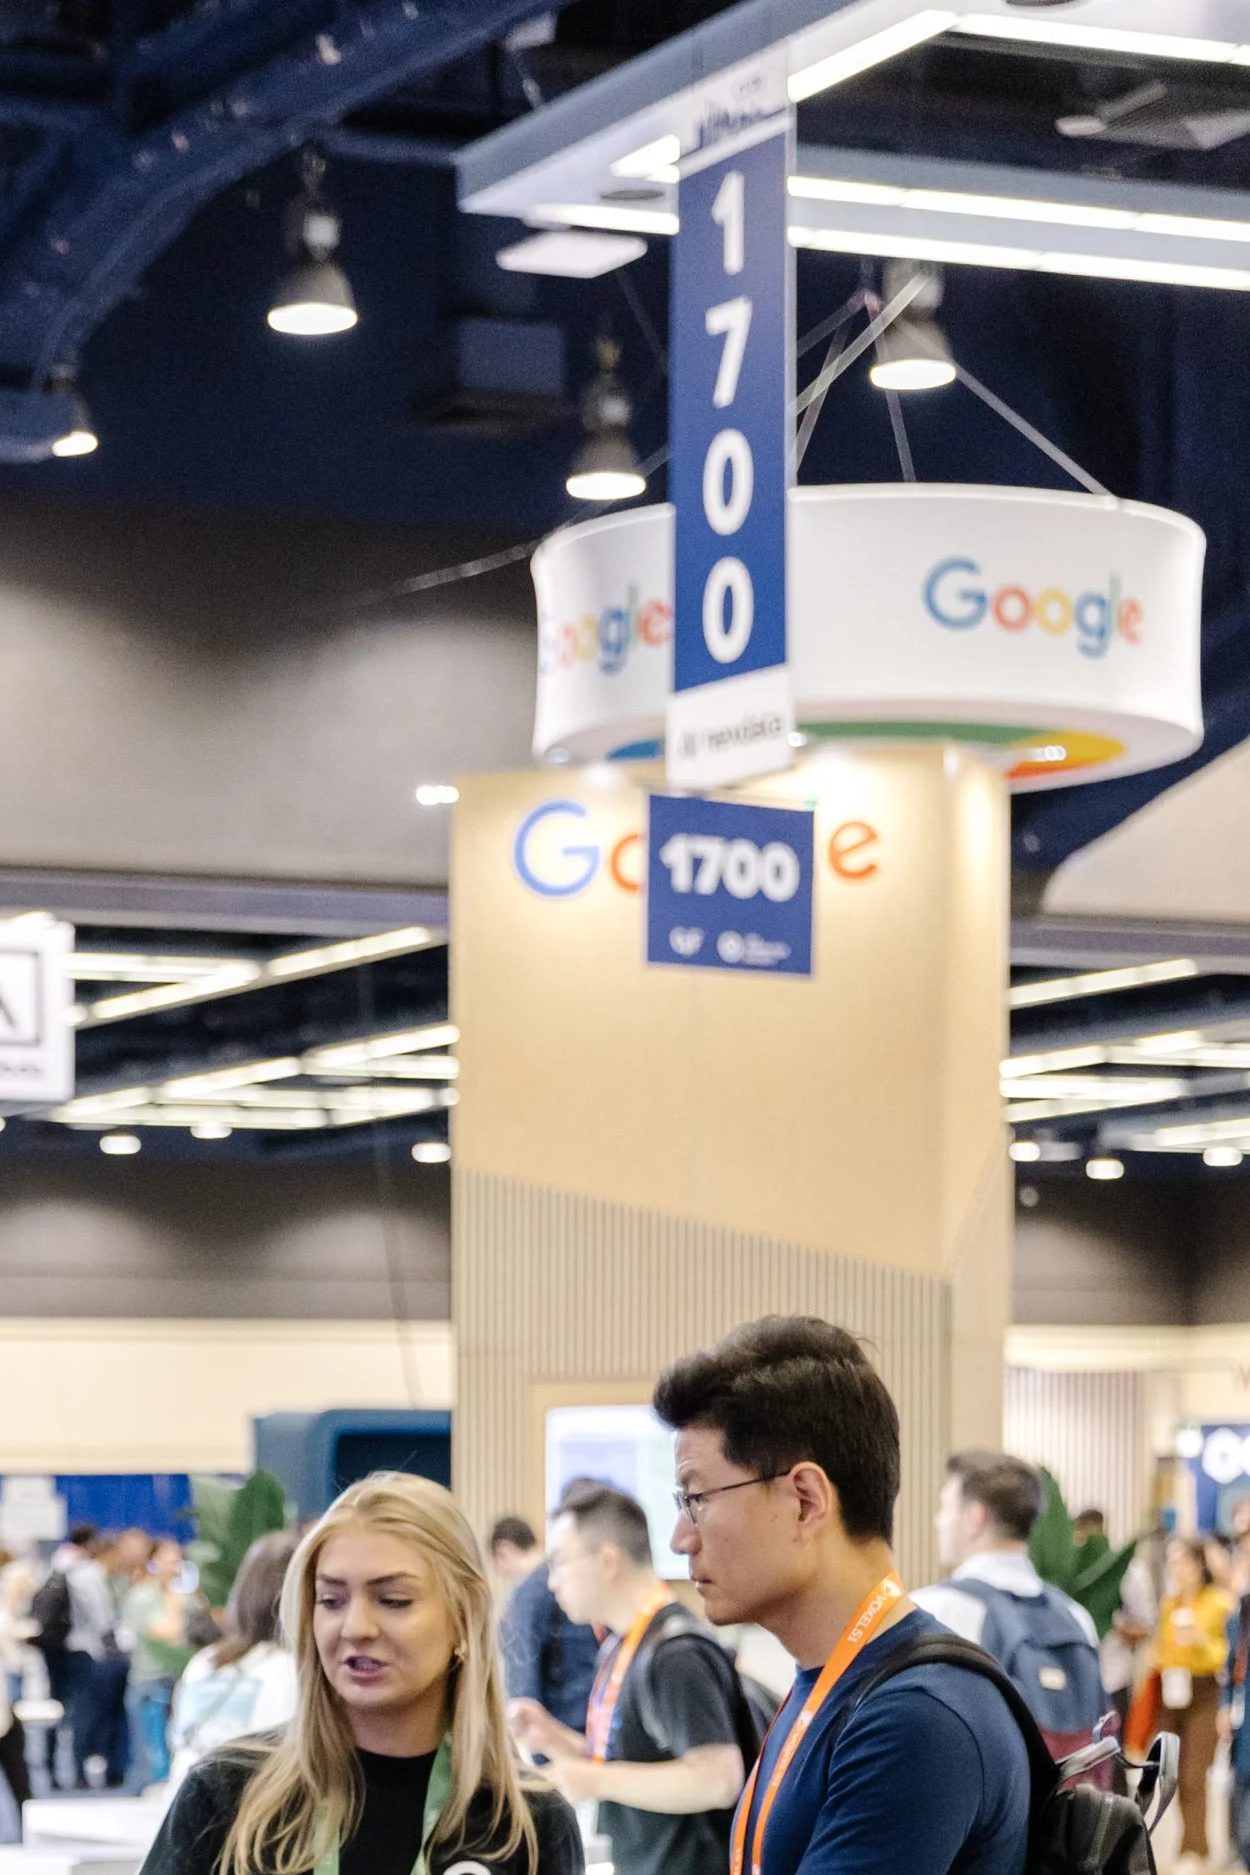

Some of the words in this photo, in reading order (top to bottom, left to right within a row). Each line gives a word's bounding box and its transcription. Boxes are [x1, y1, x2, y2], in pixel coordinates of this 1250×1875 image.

[703, 170, 753, 665] 1700
[923, 556, 1143, 660] Google
[660, 832, 801, 902] 1700
